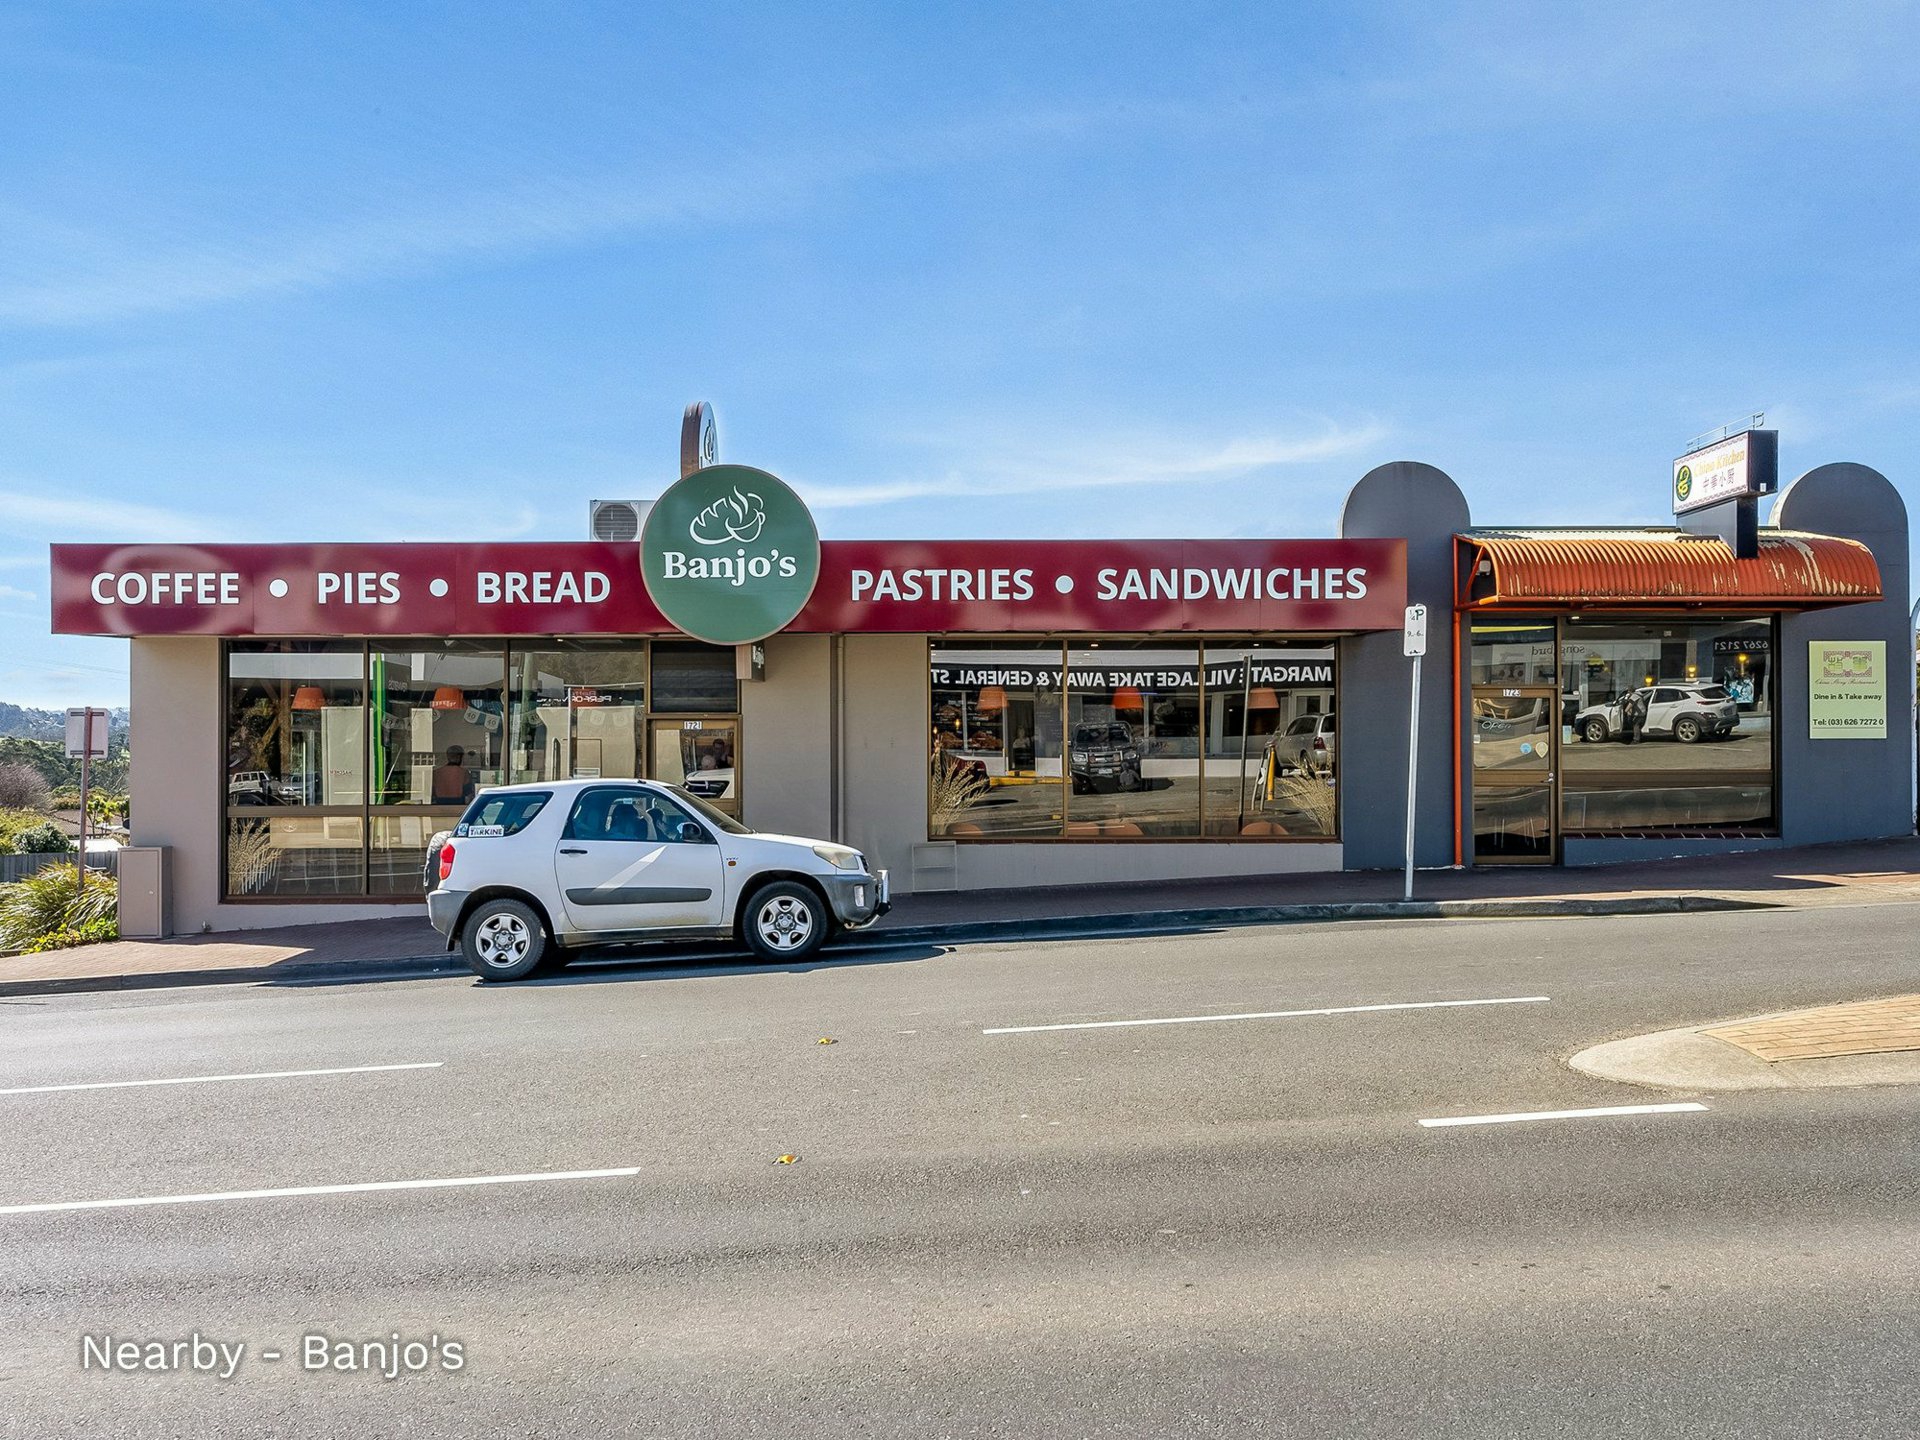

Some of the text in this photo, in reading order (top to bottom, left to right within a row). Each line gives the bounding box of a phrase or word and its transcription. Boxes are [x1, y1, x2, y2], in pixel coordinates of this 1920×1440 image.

[662, 548, 799, 587] Banjo's
[90, 571, 611, 606] COFFEE PIES BREAD
[851, 567, 1368, 602] PASTRIES SANDWICHES
[684, 721, 703, 730] 1721
[1481, 720, 1512, 730] Open
[1813, 718, 1884, 727] Tel: (03) 626 7272 0
[470, 828, 503, 836] TARKINE
